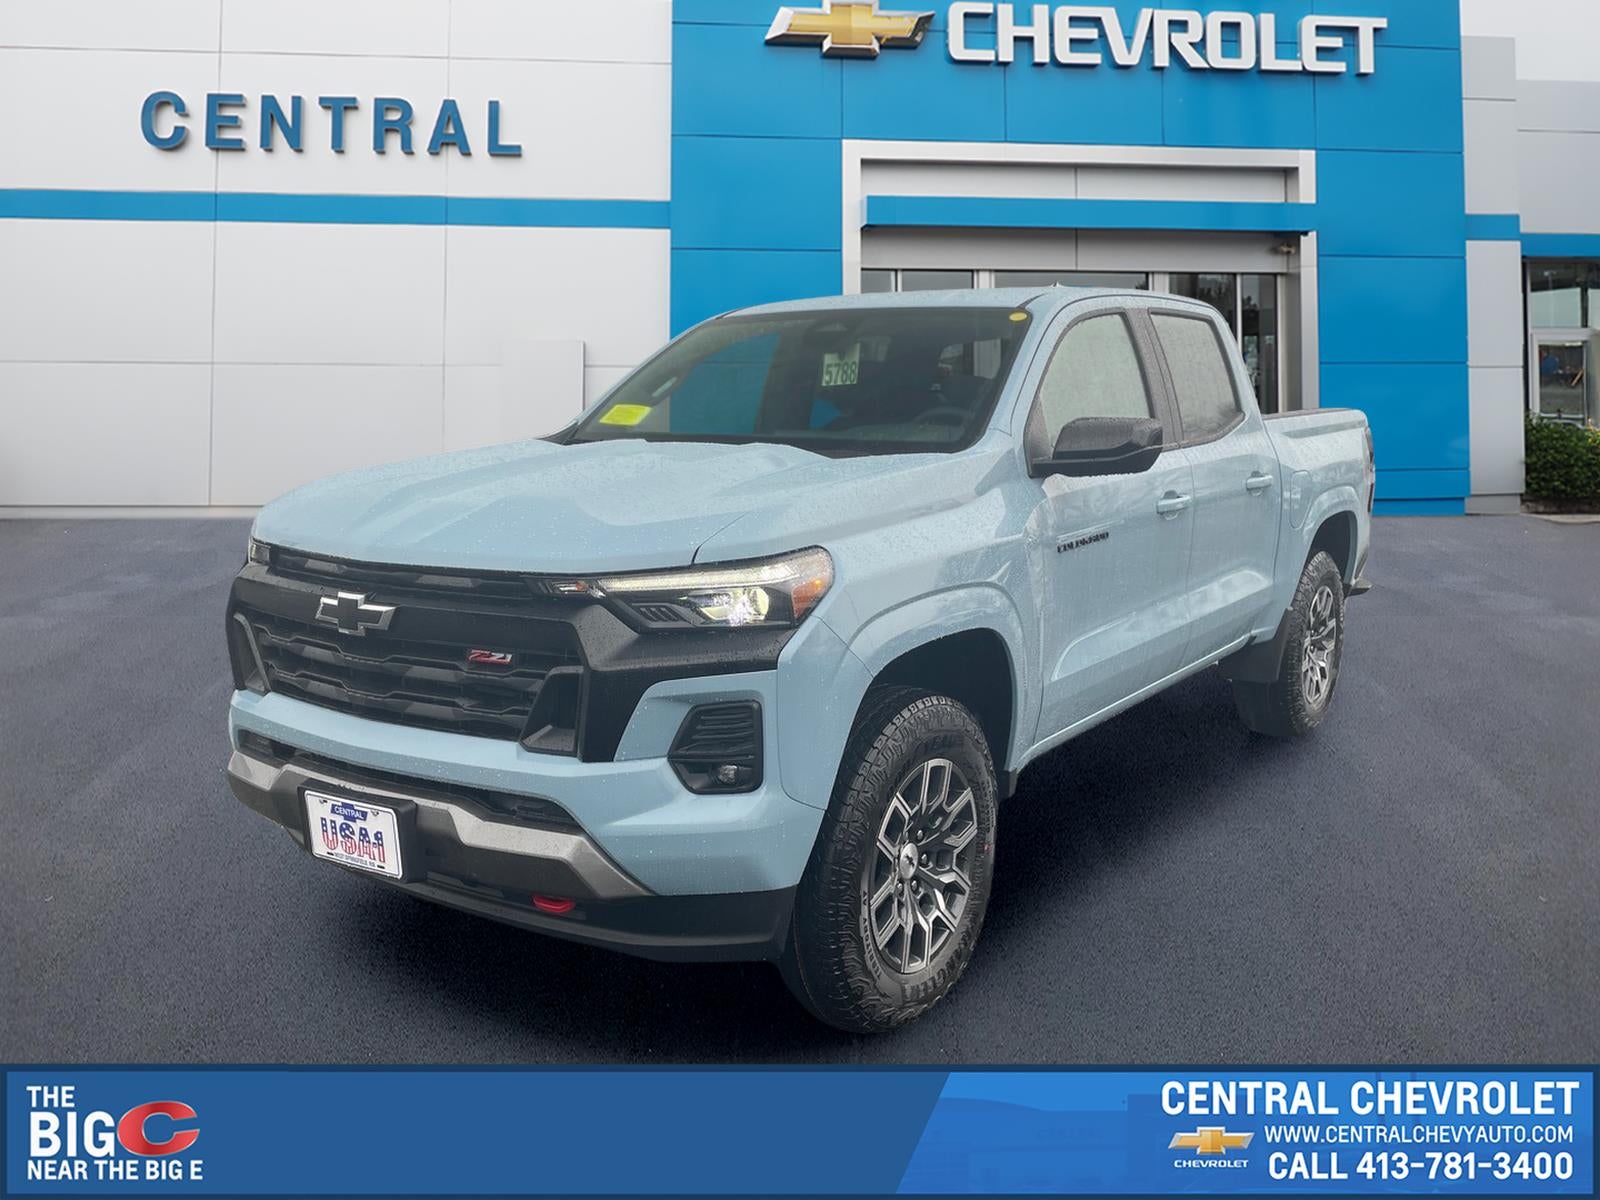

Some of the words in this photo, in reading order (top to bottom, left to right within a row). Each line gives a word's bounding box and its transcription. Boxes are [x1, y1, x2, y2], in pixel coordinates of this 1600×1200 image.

[947, 1, 1388, 74] CHEVROLET
[140, 91, 522, 157] CENTRAL
[825, 361, 857, 384] 5788
[334, 806, 364, 819] CENTRAL
